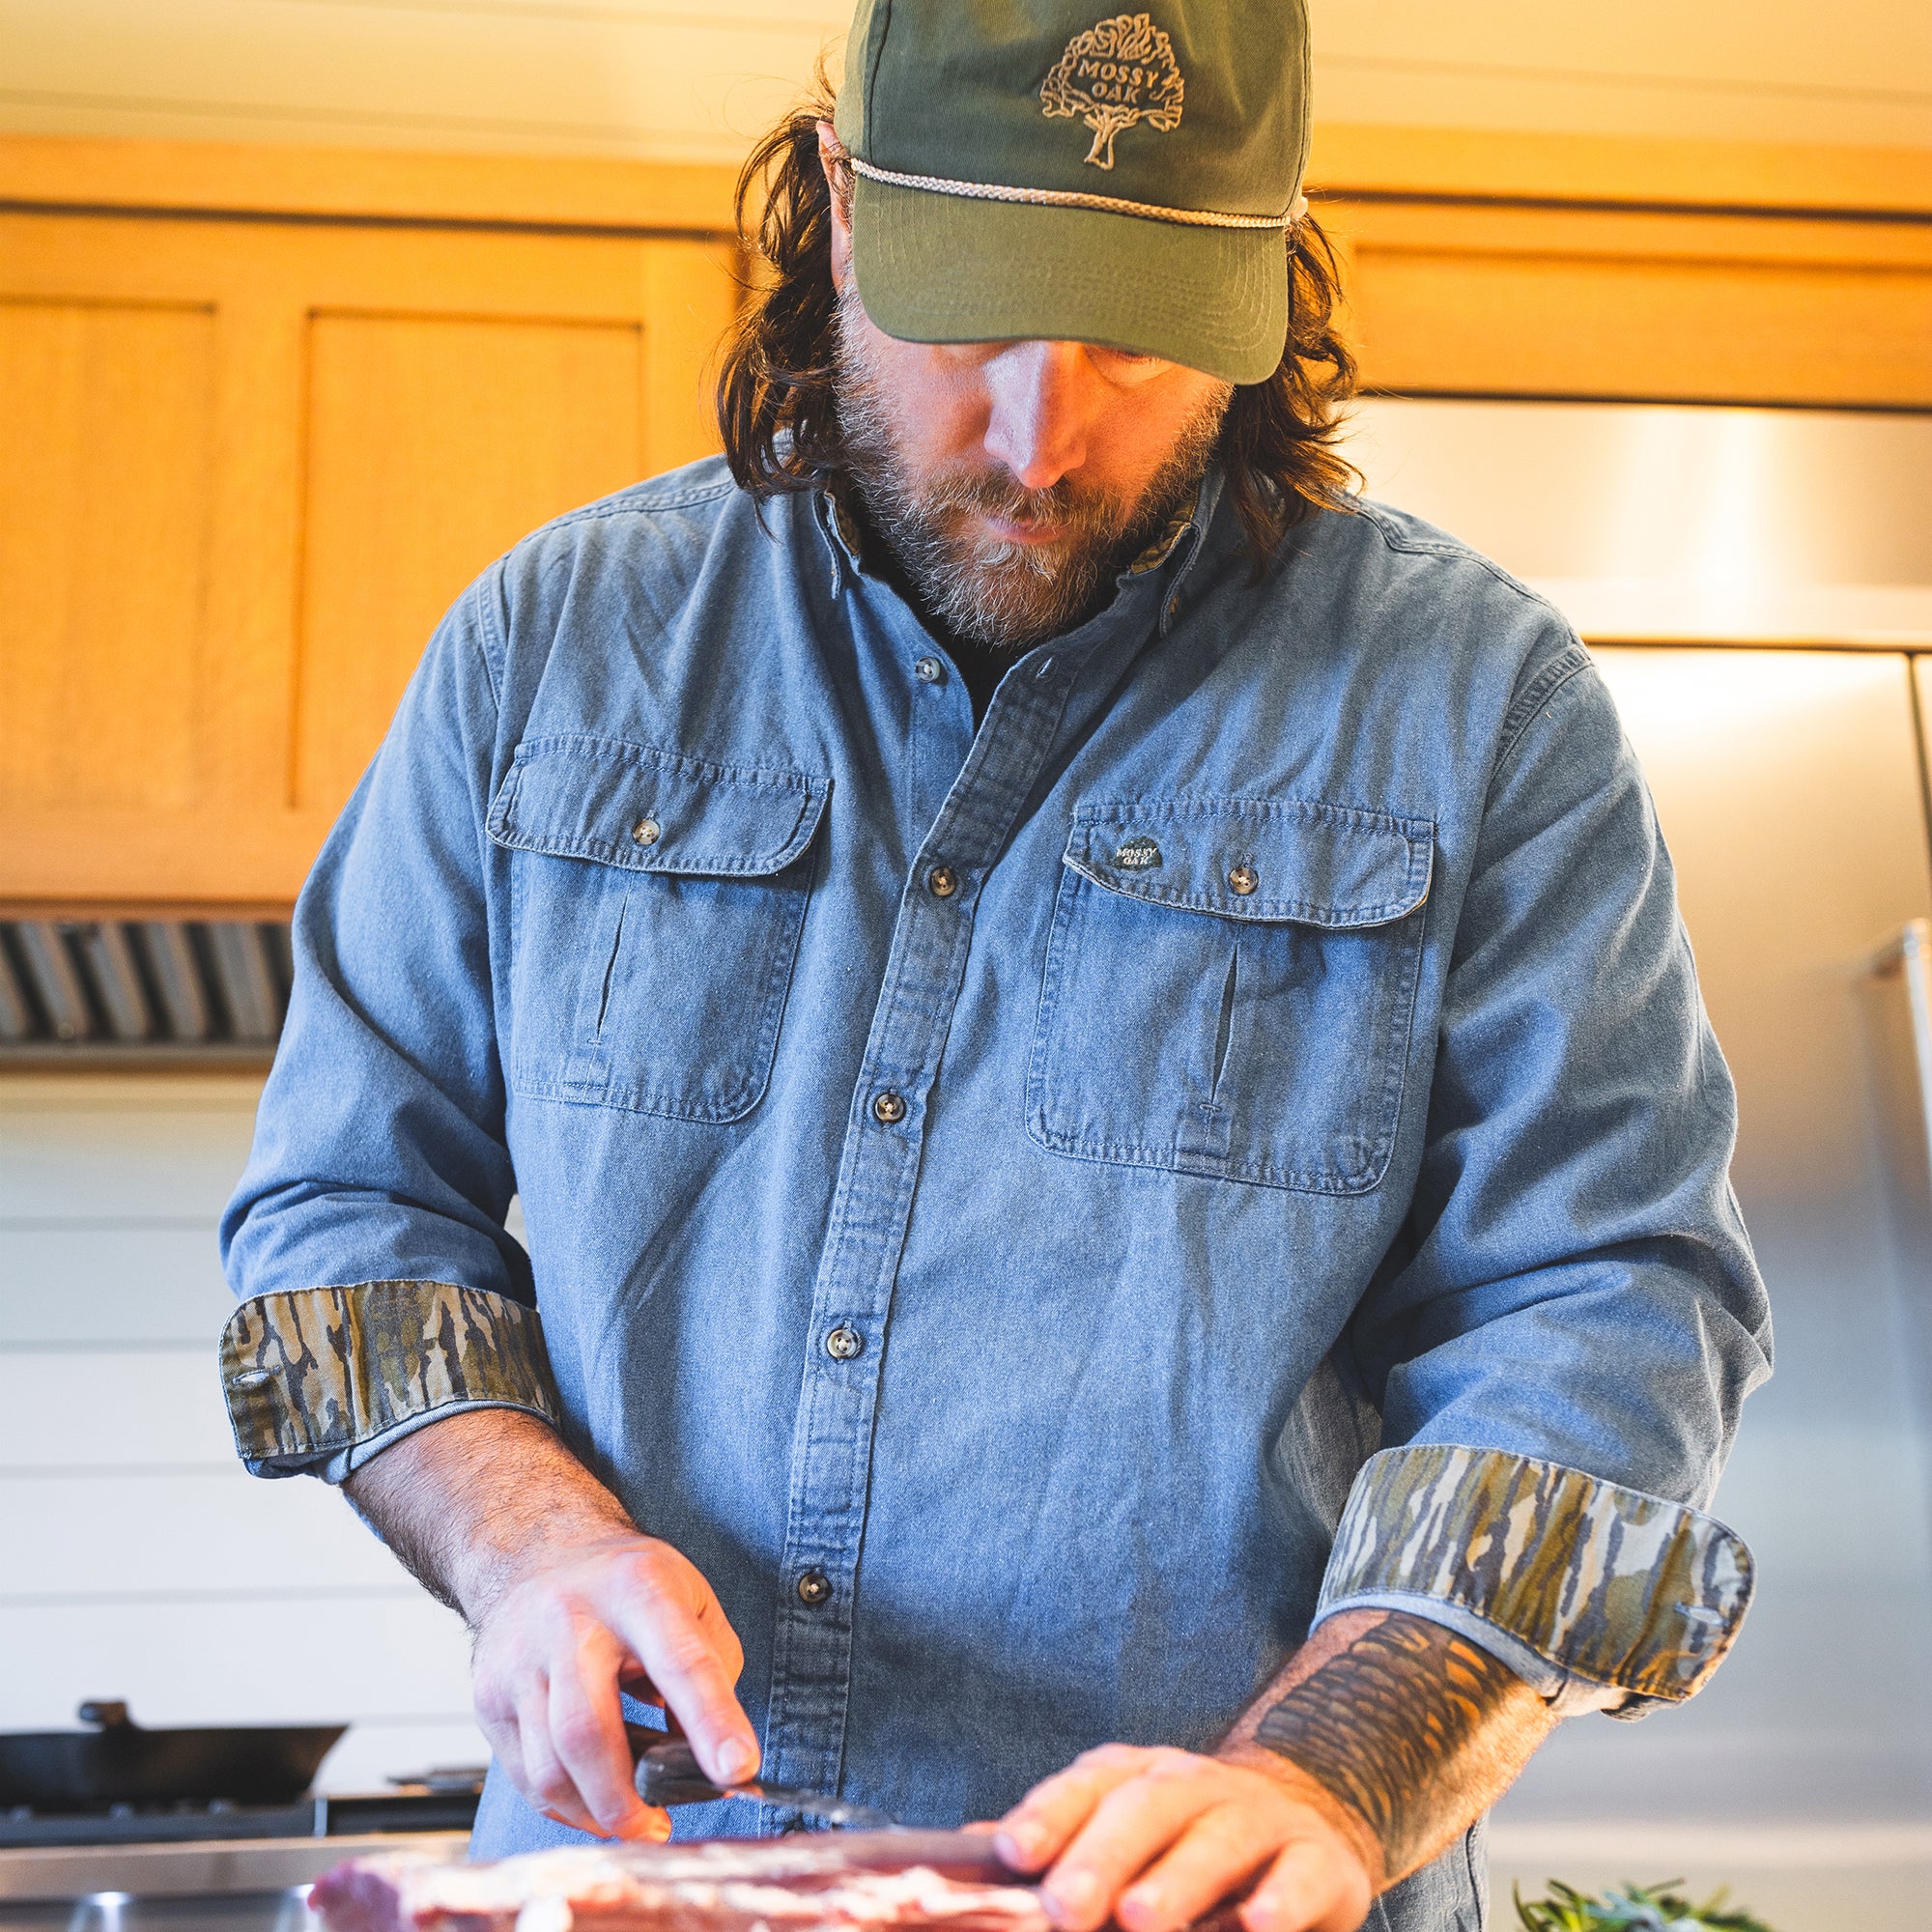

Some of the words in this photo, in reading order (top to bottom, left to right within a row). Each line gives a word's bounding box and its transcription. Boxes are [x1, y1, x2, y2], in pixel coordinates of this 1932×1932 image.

[1077, 59, 1159, 88] MOSSY
[1092, 81, 1141, 103] OAK
[1116, 847, 1158, 858] MOSSY
[1122, 856, 1151, 866] OAK
